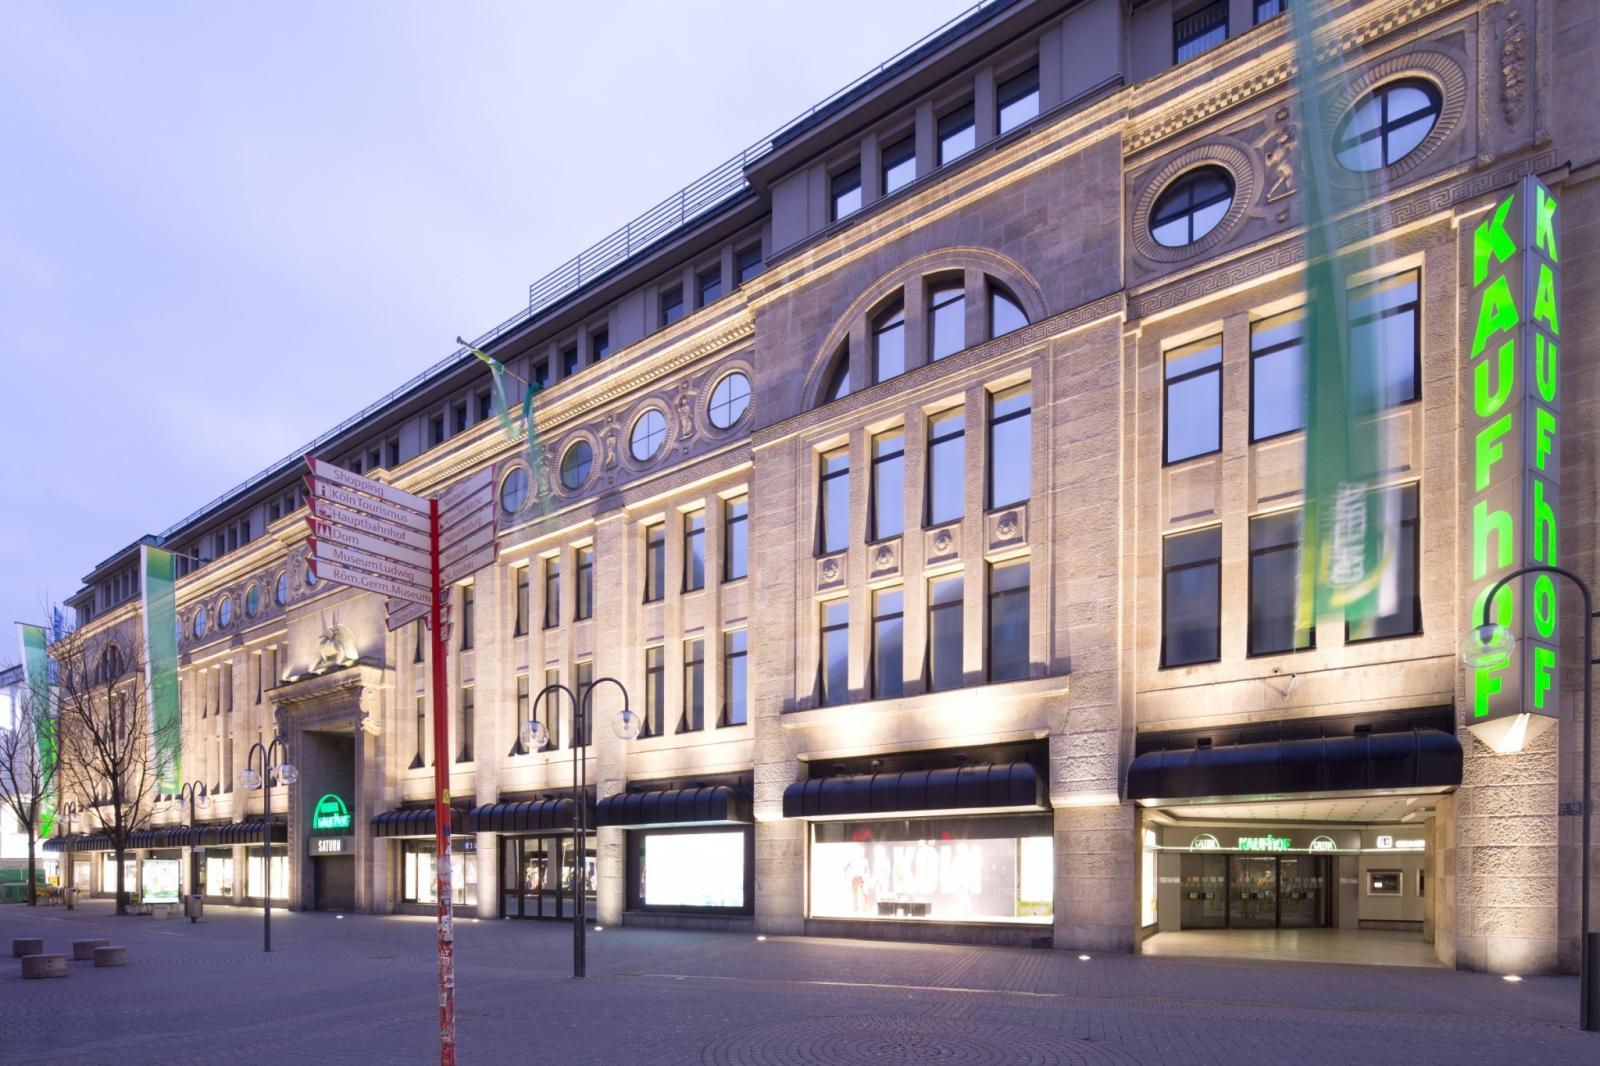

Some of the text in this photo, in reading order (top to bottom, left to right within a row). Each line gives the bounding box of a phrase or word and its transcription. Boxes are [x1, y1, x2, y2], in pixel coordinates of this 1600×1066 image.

[333, 469, 384, 497] Shopping
[333, 509, 406, 541] Hauptbahnhof
[333, 528, 359, 545] Dom
[334, 549, 414, 582] Museum Ludwig
[318, 839, 342, 852] SATURN
